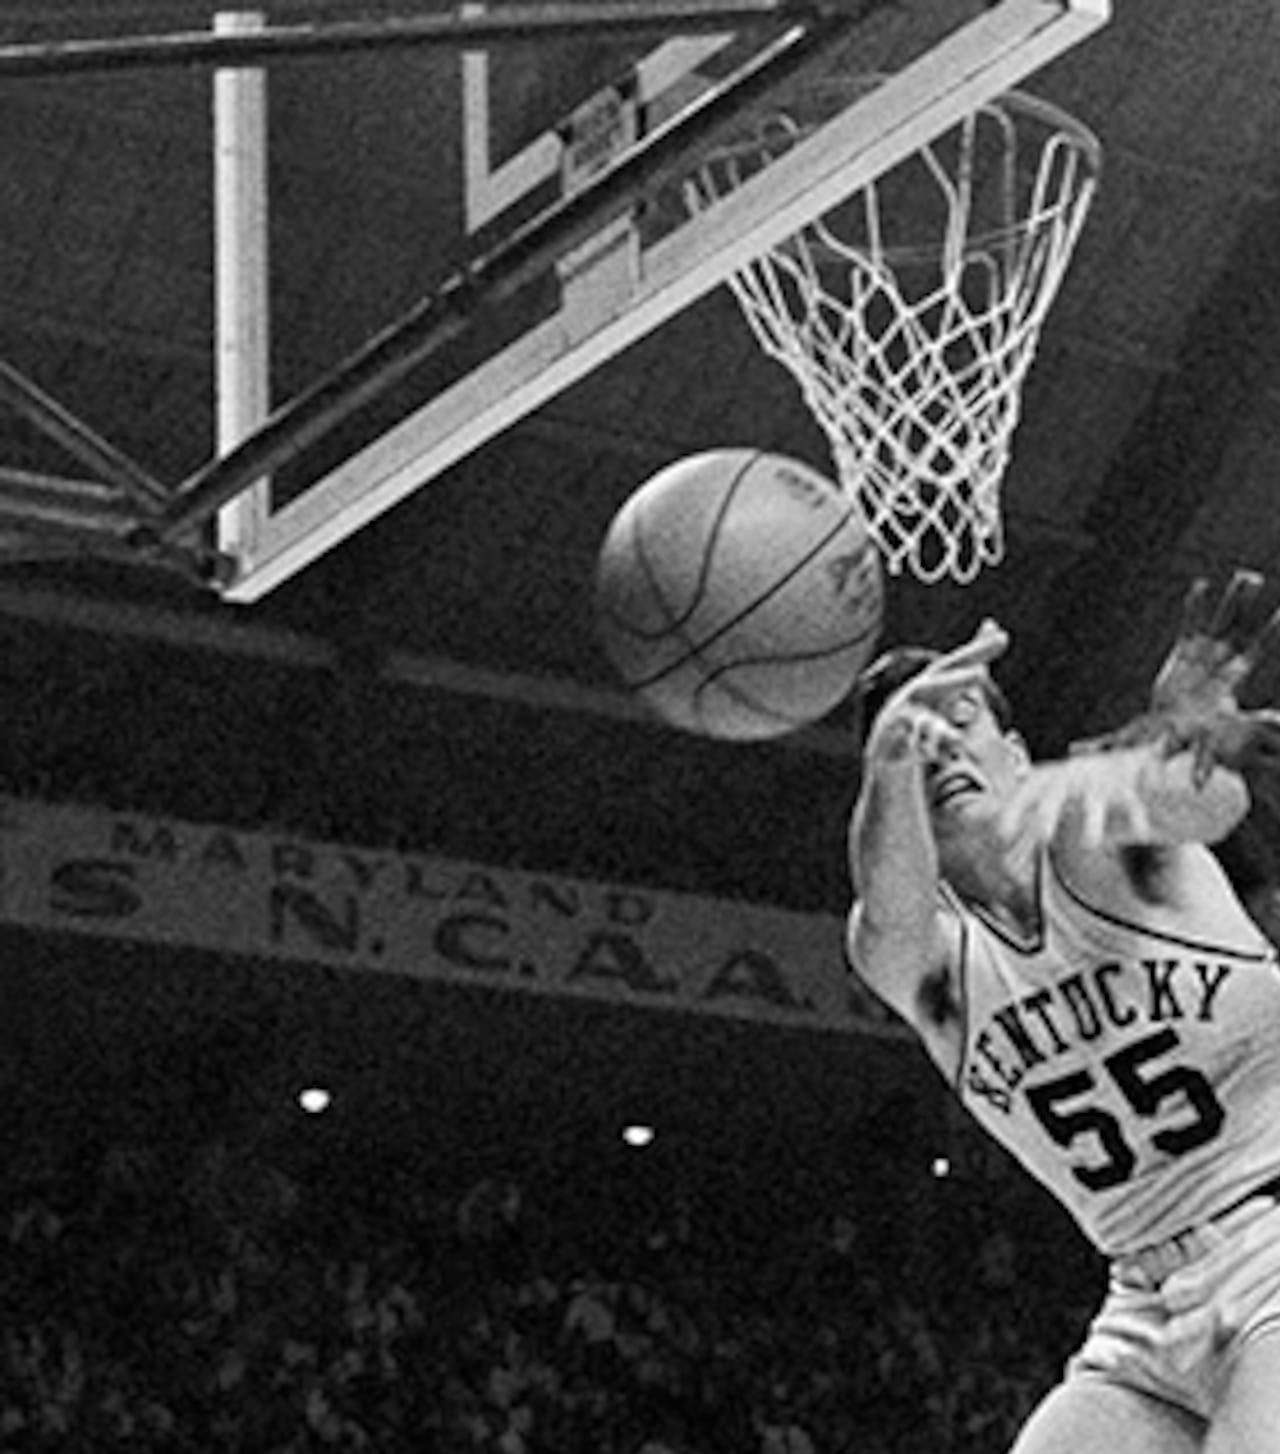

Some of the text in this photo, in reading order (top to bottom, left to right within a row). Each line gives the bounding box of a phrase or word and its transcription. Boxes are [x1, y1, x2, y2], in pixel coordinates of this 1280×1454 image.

[112, 821, 653, 925] MARYLAND
[968, 960, 1231, 1115] KENTUCKY
[1024, 1026, 1227, 1192] 55
